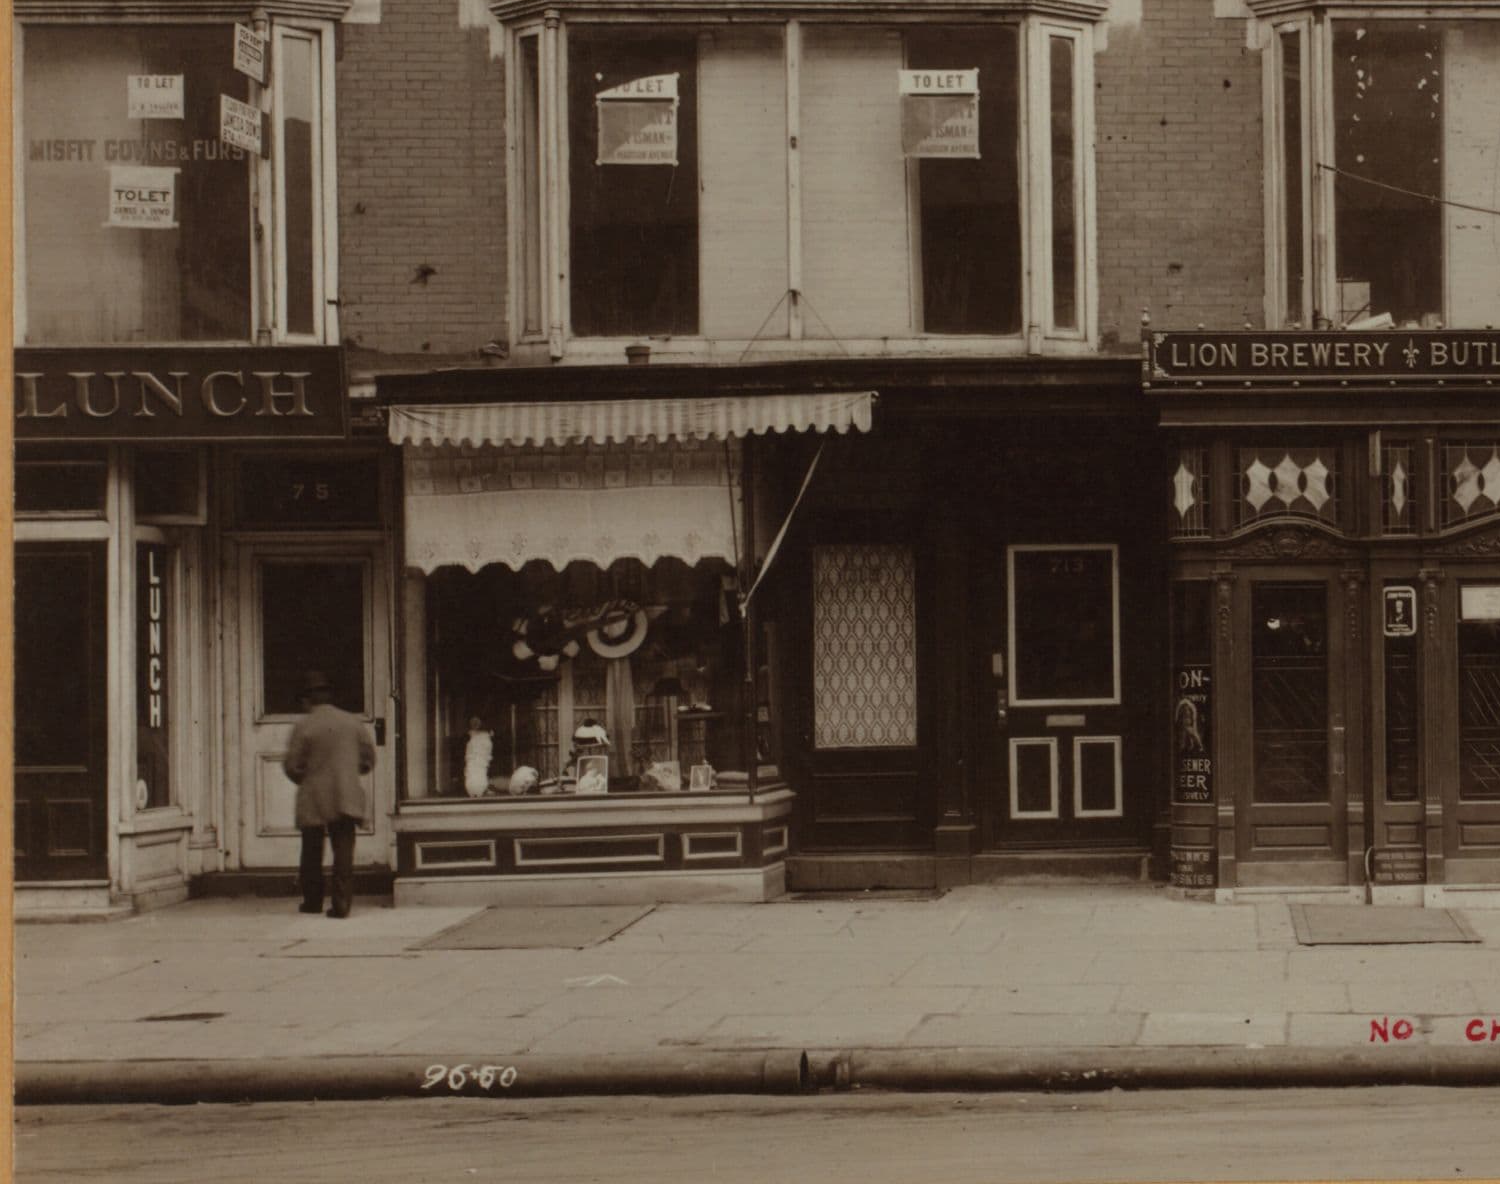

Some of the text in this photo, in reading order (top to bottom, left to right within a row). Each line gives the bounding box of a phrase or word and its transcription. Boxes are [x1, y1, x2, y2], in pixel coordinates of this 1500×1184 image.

[155, 77, 174, 89] LET
[636, 79, 664, 93] LET
[912, 75, 964, 88] TO LET
[29, 140, 97, 161] MISFIT
[104, 140, 177, 161] GOWNS
[193, 140, 245, 161] FURS
[1172, 343, 1237, 366] LION
[1251, 342, 1390, 366] BREWERY
[16, 370, 314, 416] LUNCH
[149, 550, 161, 729] LUNCH
